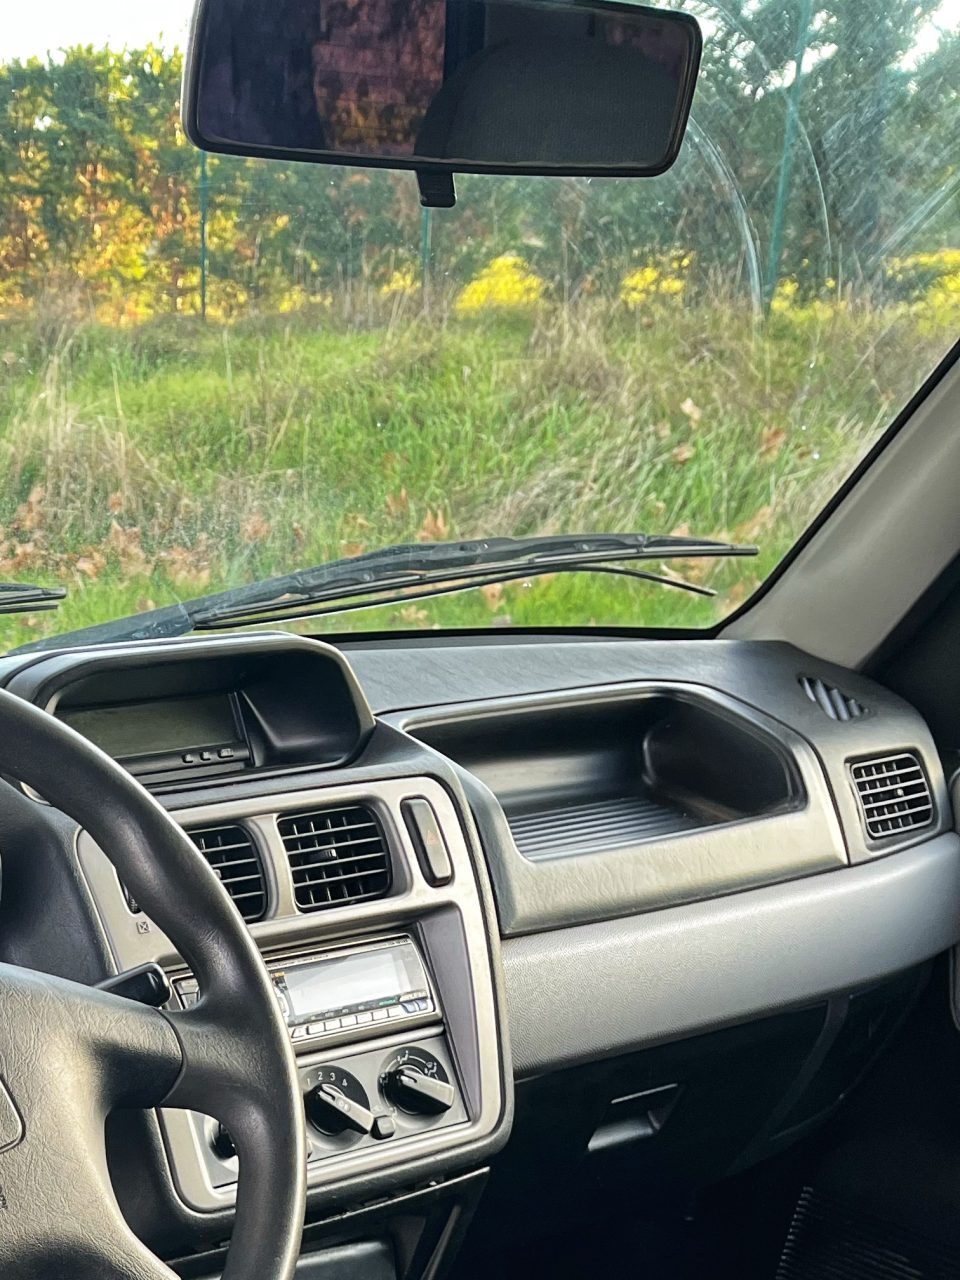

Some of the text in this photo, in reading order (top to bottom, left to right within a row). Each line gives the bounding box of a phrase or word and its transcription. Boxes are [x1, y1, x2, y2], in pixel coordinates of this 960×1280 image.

[317, 1072, 323, 1081] 2
[330, 1072, 336, 1081] 3
[341, 1078, 348, 1087] 4
